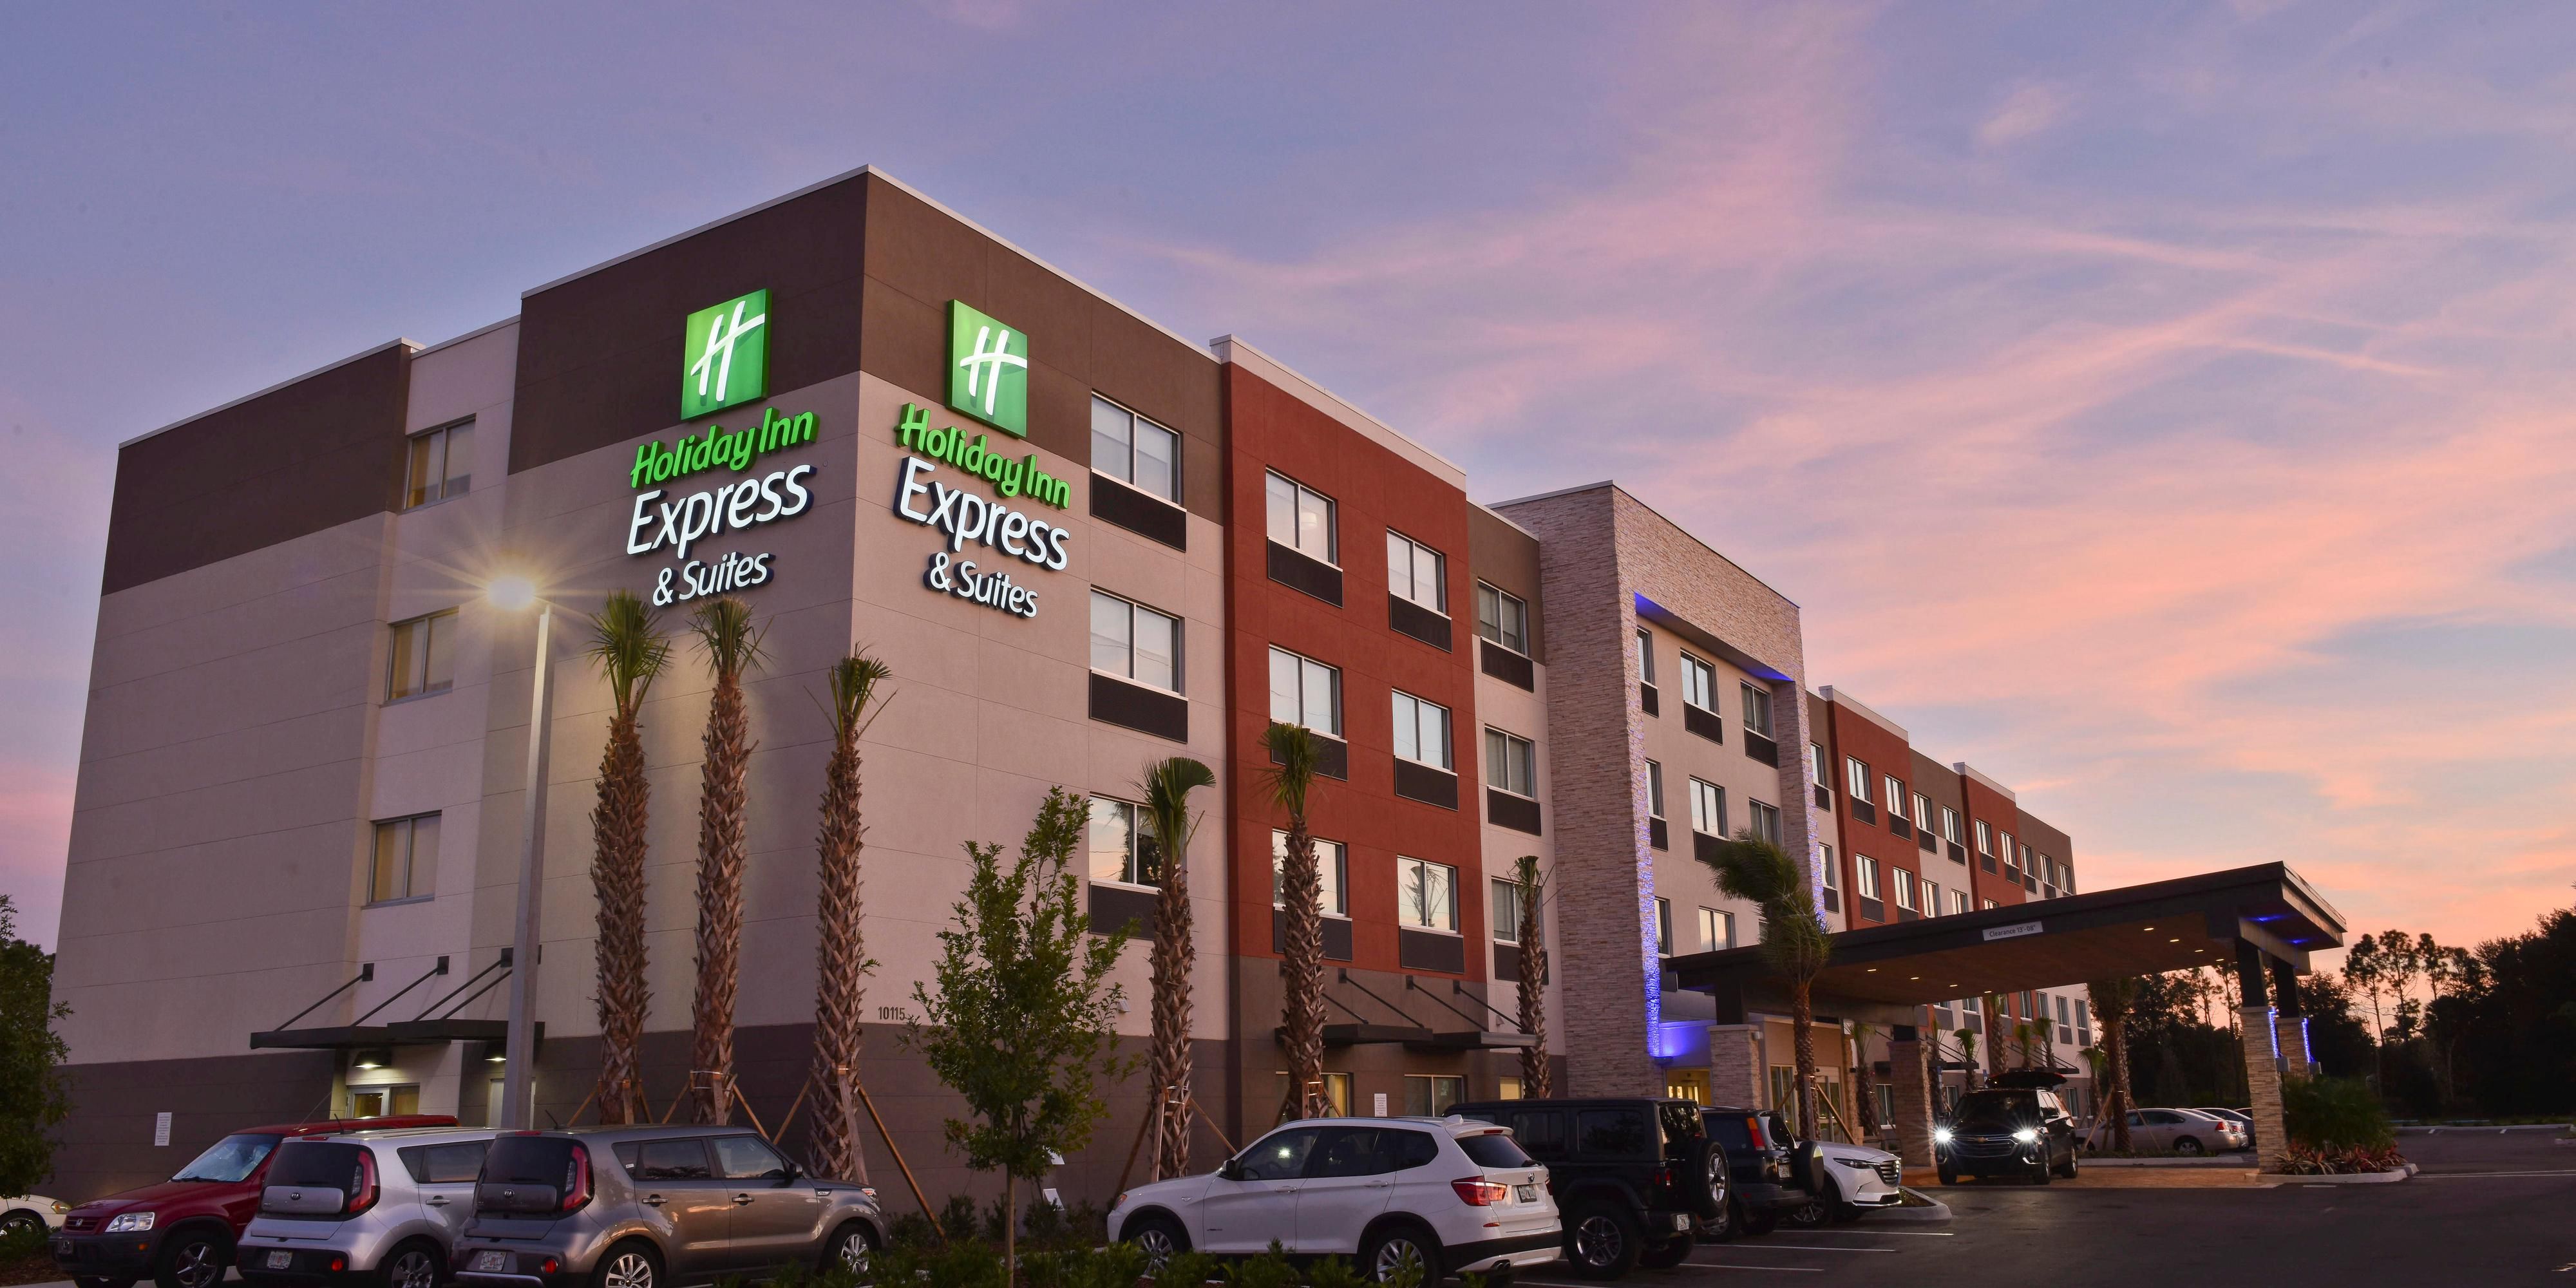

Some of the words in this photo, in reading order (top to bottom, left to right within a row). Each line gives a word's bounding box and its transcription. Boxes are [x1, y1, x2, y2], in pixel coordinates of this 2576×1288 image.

[630, 425, 757, 489] Holiday
[759, 408, 815, 453] Inn
[899, 403, 1023, 498] Holiday
[1026, 455, 1071, 509] Inn
[627, 464, 811, 560] Express
[900, 456, 1070, 571] Express
[652, 567, 672, 607] &
[679, 551, 770, 600] Suites
[929, 553, 950, 590] &
[959, 560, 1039, 619] Suites
[878, 1006, 905, 1021] 10115
